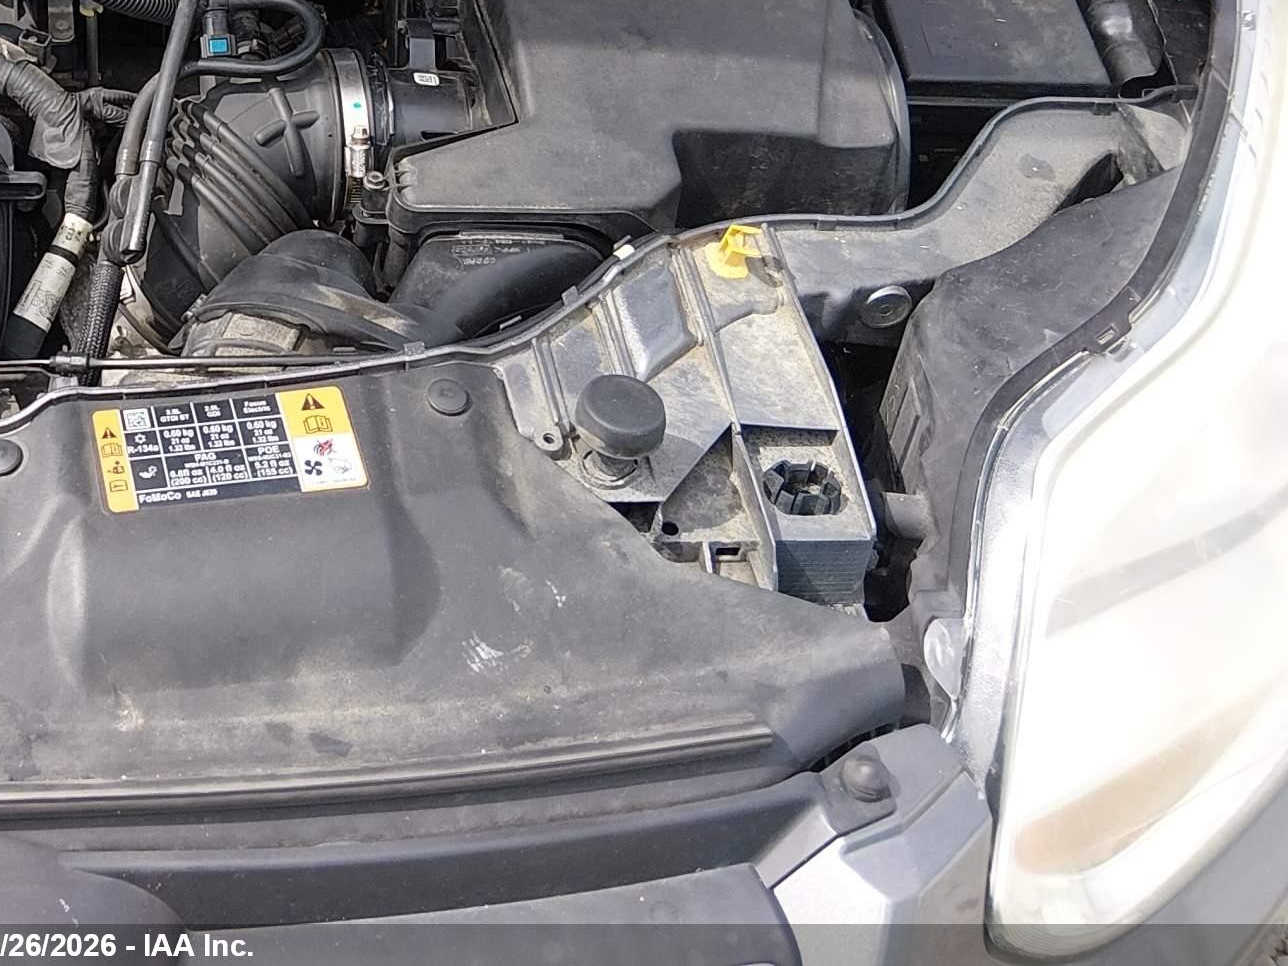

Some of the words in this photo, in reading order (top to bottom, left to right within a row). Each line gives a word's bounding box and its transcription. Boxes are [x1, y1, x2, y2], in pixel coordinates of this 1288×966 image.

[221, 424, 234, 434] kg
[265, 420, 277, 429] kg
[182, 429, 195, 438] kg
[127, 444, 159, 454] R-134a
[257, 445, 280, 455] POE
[194, 452, 217, 462] PAG
[233, 464, 245, 472] oz
[278, 459, 290, 467] oz
[278, 466, 293, 475] cc)
[212, 472, 232, 483] (120
[233, 470, 248, 480] cc)
[138, 491, 182, 504] FoMoCo
